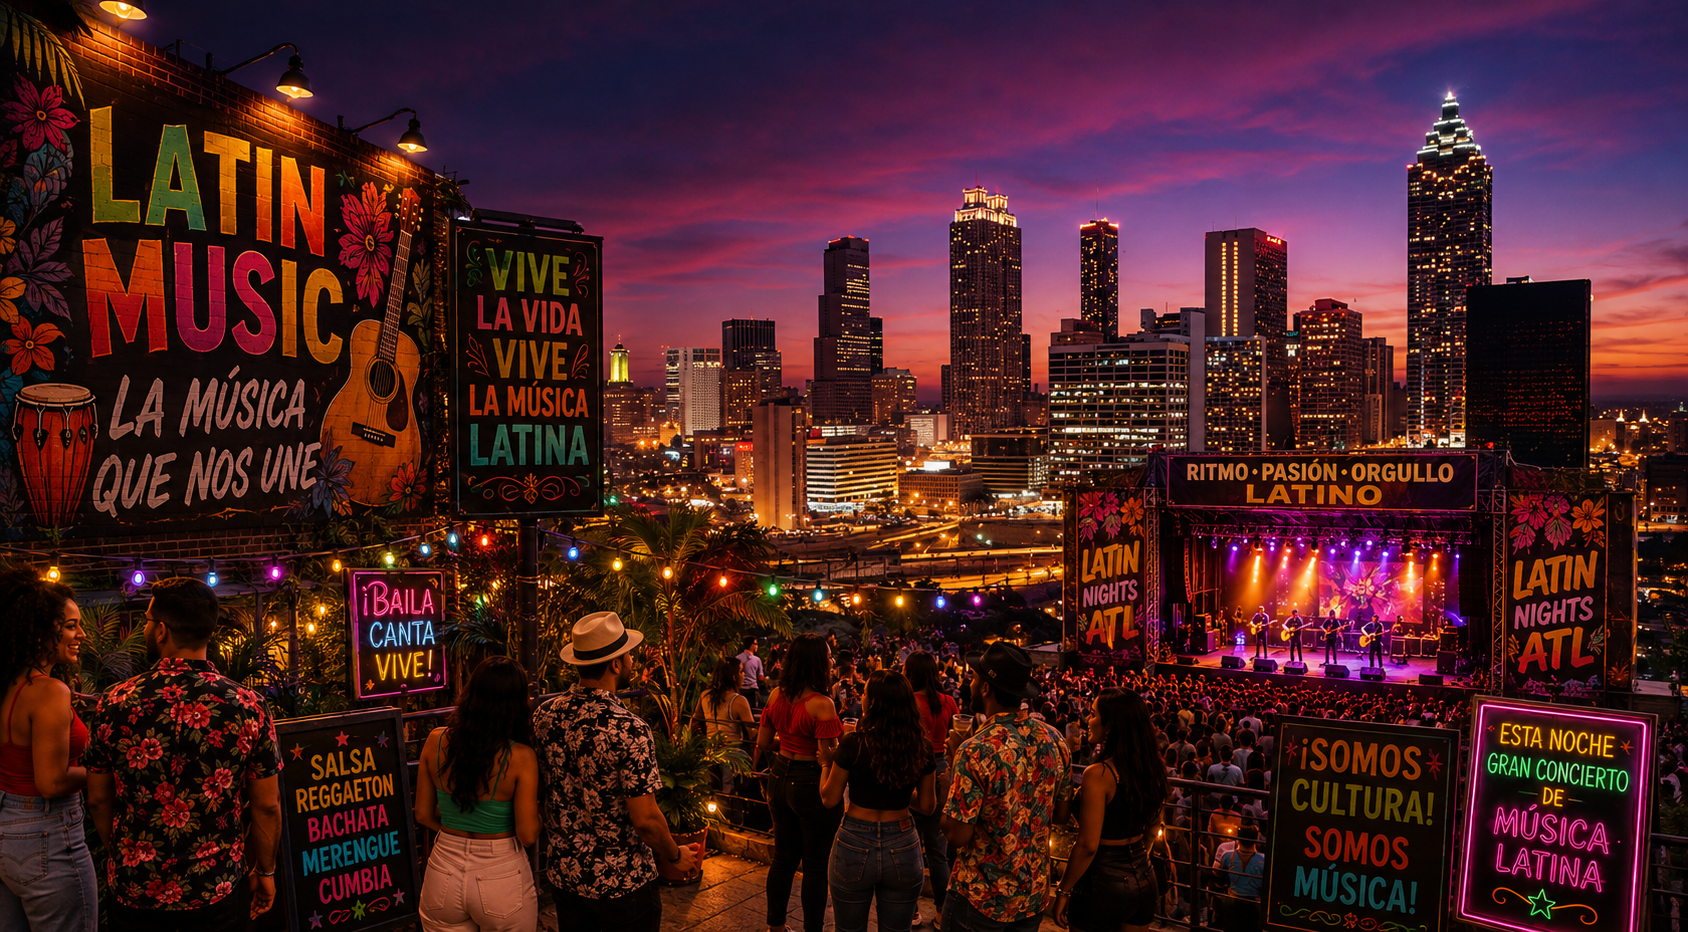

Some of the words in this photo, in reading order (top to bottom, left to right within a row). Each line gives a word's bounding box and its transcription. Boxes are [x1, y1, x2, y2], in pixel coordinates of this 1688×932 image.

[90, 105, 325, 257] LATIN
[485, 248, 570, 296] VIVE
[82, 238, 344, 364] MUSIC
[477, 294, 513, 331] LA
[521, 298, 583, 336] VIDA
[492, 338, 568, 380] VIVE
[109, 375, 164, 441] LA
[179, 365, 306, 437] MÚSICA
[469, 384, 500, 416] LA
[507, 380, 590, 418] MÚSICA
[470, 423, 590, 466] LATINA
[92, 452, 177, 518] QUE
[185, 446, 251, 506] NOS
[261, 442, 322, 494] UNE
[1187, 463, 1249, 481] RITMO
[1262, 458, 1337, 482] PASIÓN
[1351, 463, 1454, 483] ORGULLO
[1246, 484, 1383, 506] LATINO
[1081, 540, 1140, 584] LATIN
[1513, 550, 1598, 600] LATIN
[363, 580, 435, 617] ¡BAILA
[1082, 579, 1138, 608] NIGHTS
[1514, 595, 1594, 630] NIGHTS
[369, 620, 436, 648] CANTA
[1085, 605, 1139, 650] ATL
[375, 649, 433, 681] VIVE!
[1517, 626, 1595, 674] ATL
[1300, 737, 1422, 781] ¡SOMOS
[1499, 722, 1543, 749] ESTA
[1549, 728, 1616, 758] NOCHE
[310, 747, 377, 781] SALSA
[1487, 752, 1532, 779] GRAN
[1536, 758, 1630, 793] CONCIERTO
[296, 773, 394, 813] REGGAETON
[1290, 777, 1435, 826] CULTURA!
[1542, 786, 1564, 807] DE
[307, 803, 389, 842] BACHATA
[1493, 803, 1610, 855] MÚSICA
[302, 830, 401, 876] MERENGUE
[1304, 825, 1410, 870] SOMOS
[1495, 843, 1602, 893] LATINA
[319, 864, 392, 904] CUMBIA
[1293, 863, 1418, 915] MÚSICA!
